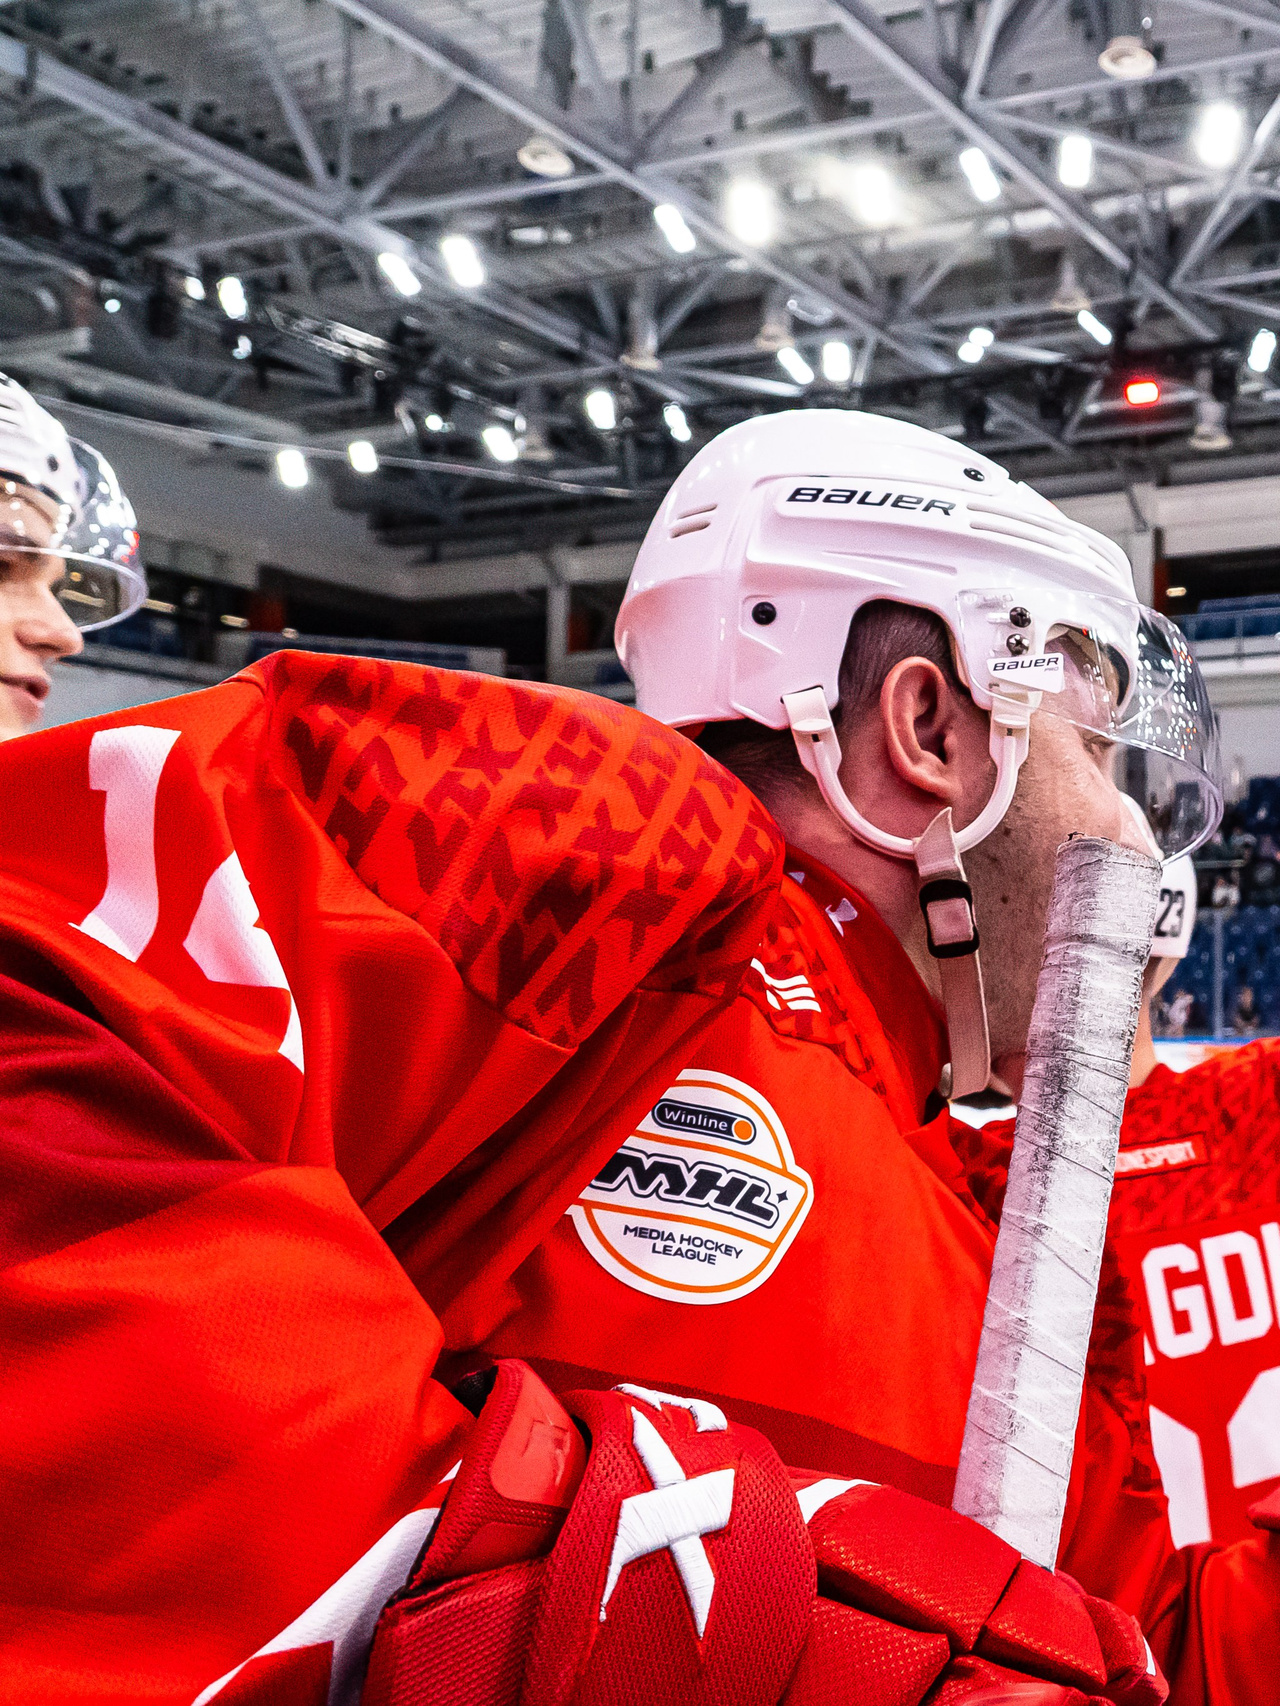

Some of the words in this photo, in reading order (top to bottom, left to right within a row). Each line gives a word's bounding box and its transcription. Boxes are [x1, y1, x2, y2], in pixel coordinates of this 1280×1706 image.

[786, 486, 957, 517] BAUER
[992, 657, 1060, 672] BAUER
[1155, 888, 1185, 937] 23
[664, 1107, 729, 1131] Winline
[594, 1153, 775, 1221] MHL
[623, 1225, 676, 1243] MEDIA
[680, 1234, 743, 1259] HOCKEY
[651, 1242, 717, 1265] LEAGUE
